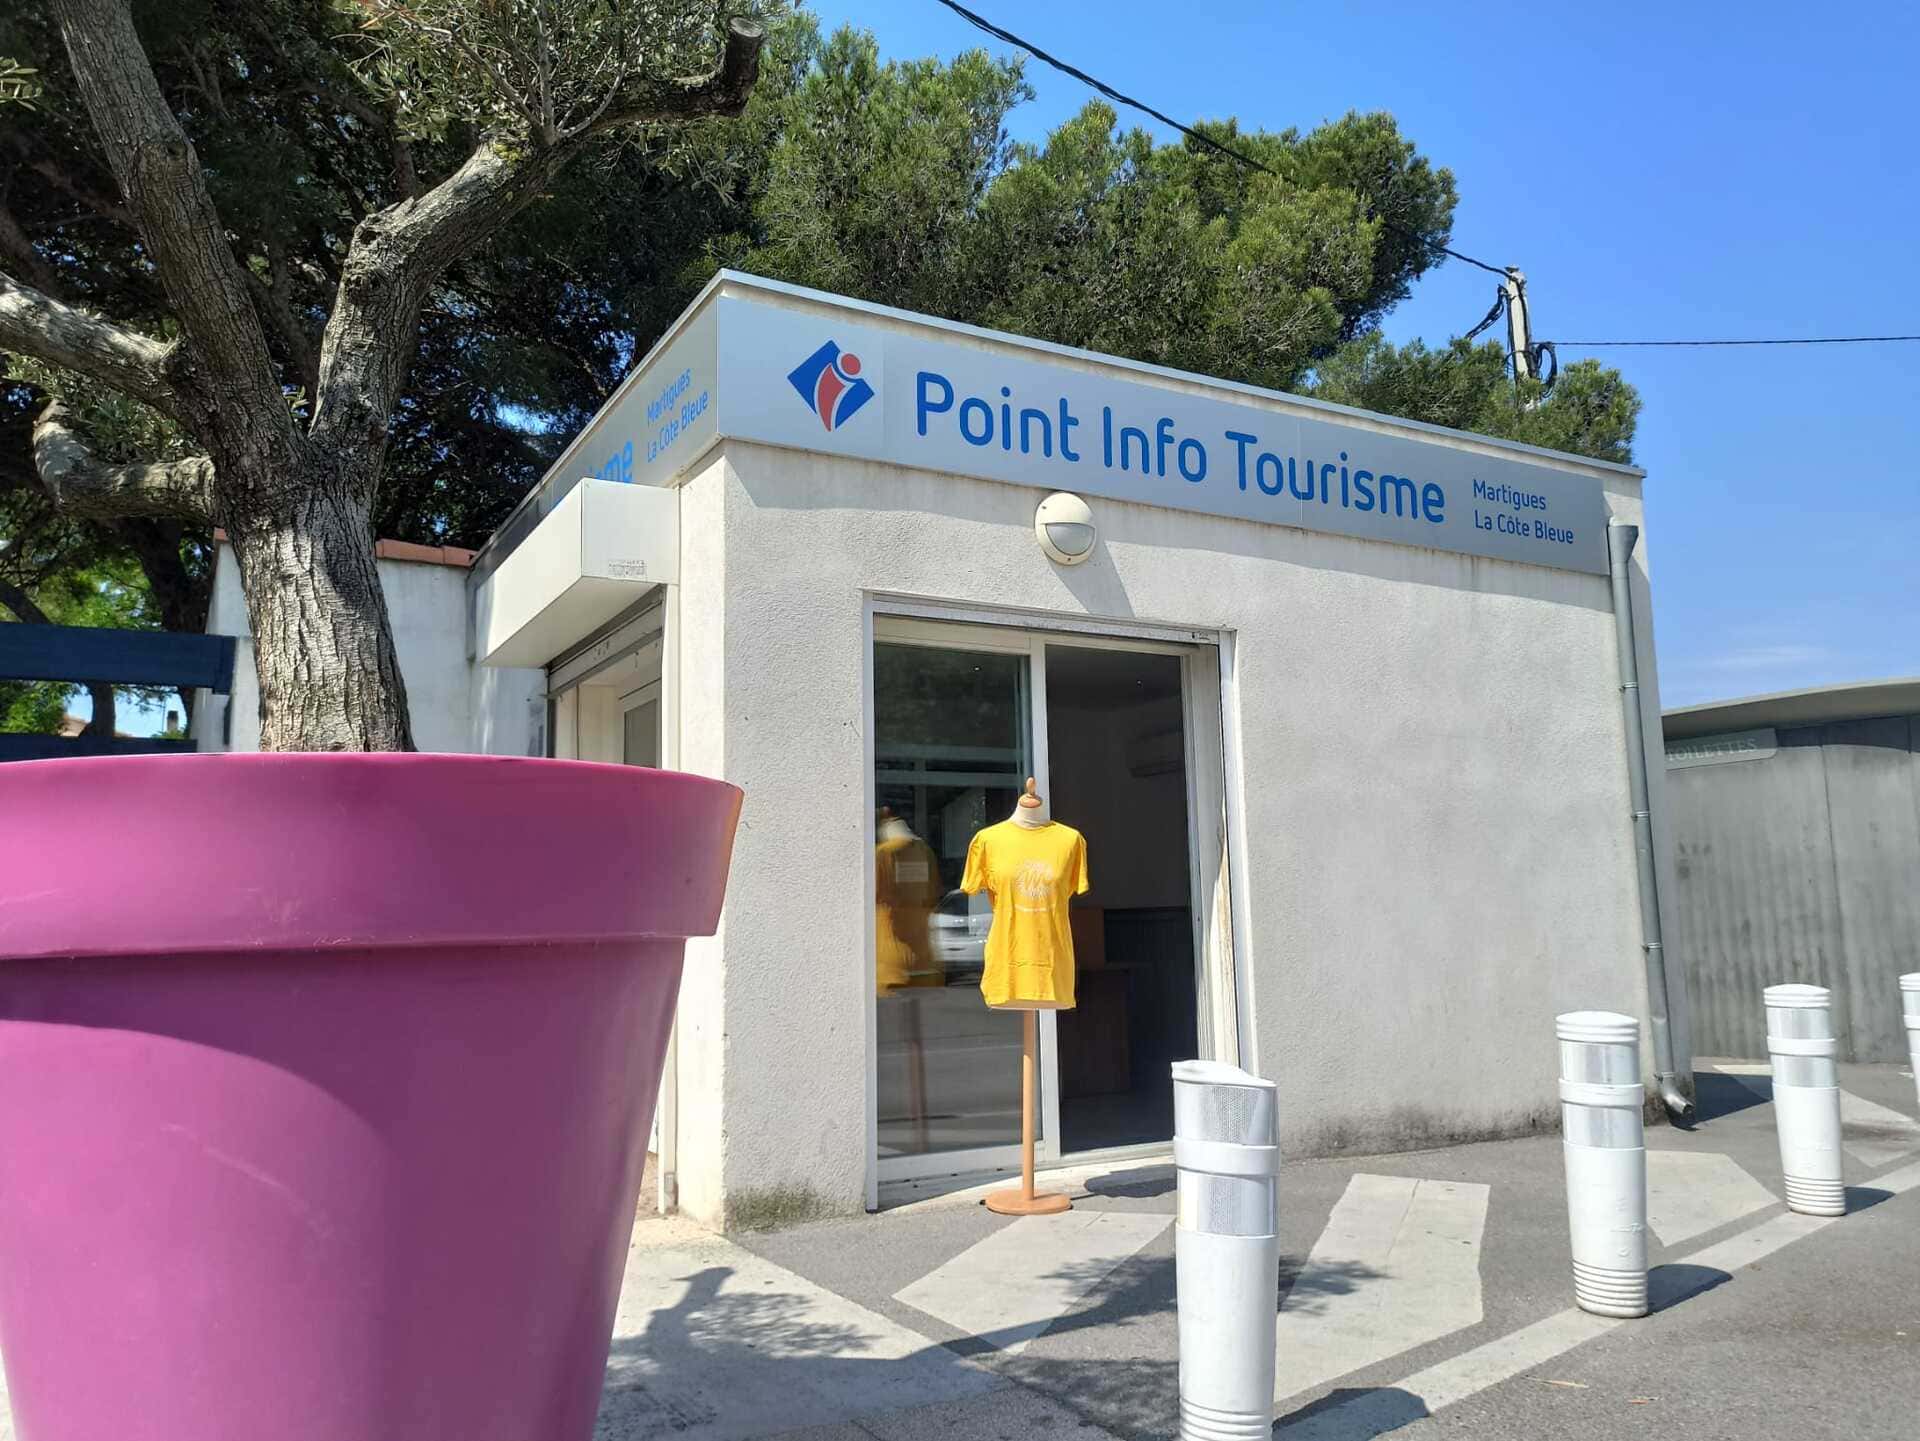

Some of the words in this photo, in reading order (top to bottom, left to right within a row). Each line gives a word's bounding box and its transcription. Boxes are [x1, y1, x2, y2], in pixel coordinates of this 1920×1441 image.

[647, 368, 691, 426] Martigues
[647, 440, 657, 463] La
[681, 391, 708, 431] Bleue
[916, 371, 1080, 462] Point
[1103, 406, 1207, 483] Info
[1224, 430, 1445, 523] Tourisme
[1473, 479, 1547, 511] Martigues
[1474, 509, 1493, 531] La
[1497, 513, 1530, 537] Côte
[1534, 520, 1574, 544] Bleue
